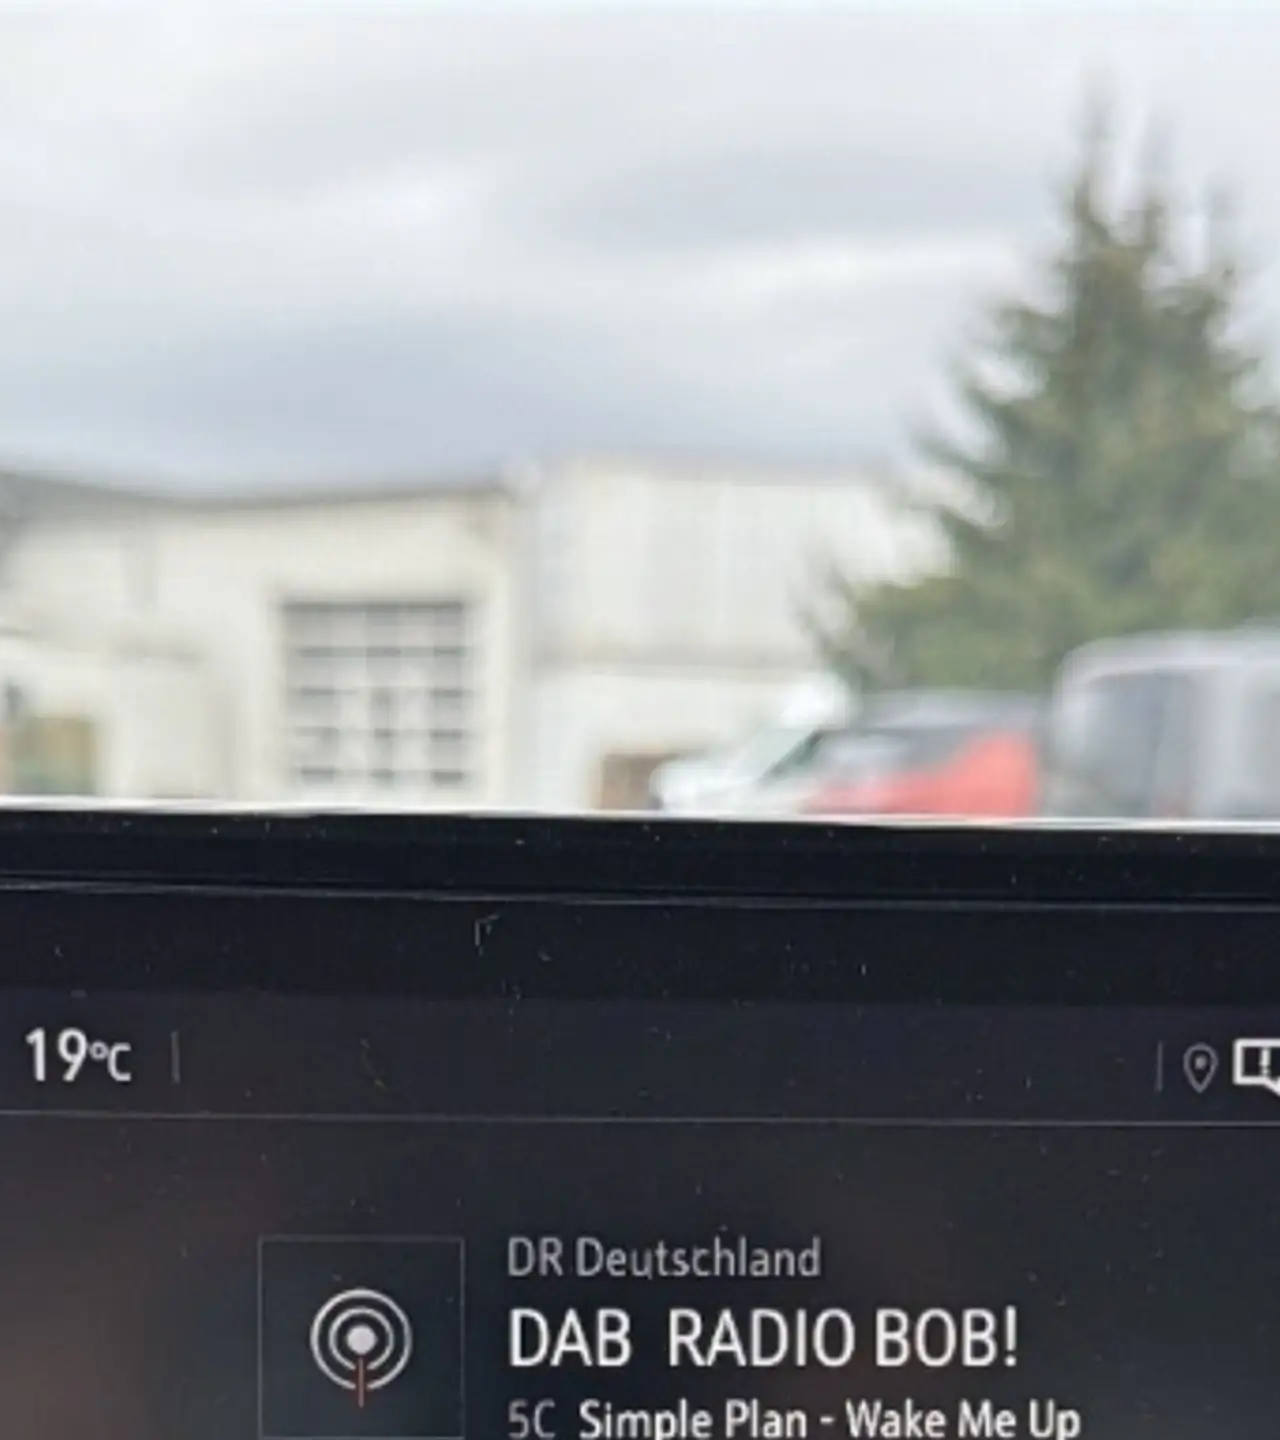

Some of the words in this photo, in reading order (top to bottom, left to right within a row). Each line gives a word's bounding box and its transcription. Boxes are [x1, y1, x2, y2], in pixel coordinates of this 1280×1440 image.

[508, 1236, 564, 1277] DR
[576, 1236, 820, 1279] Deutschland
[510, 1308, 631, 1367] DAB
[669, 1308, 855, 1368] RADIO
[876, 1305, 1017, 1367] BOB!
[725, 1398, 807, 1439] Plan
[845, 1398, 947, 1439] Wake
[958, 1399, 1017, 1439] Me
